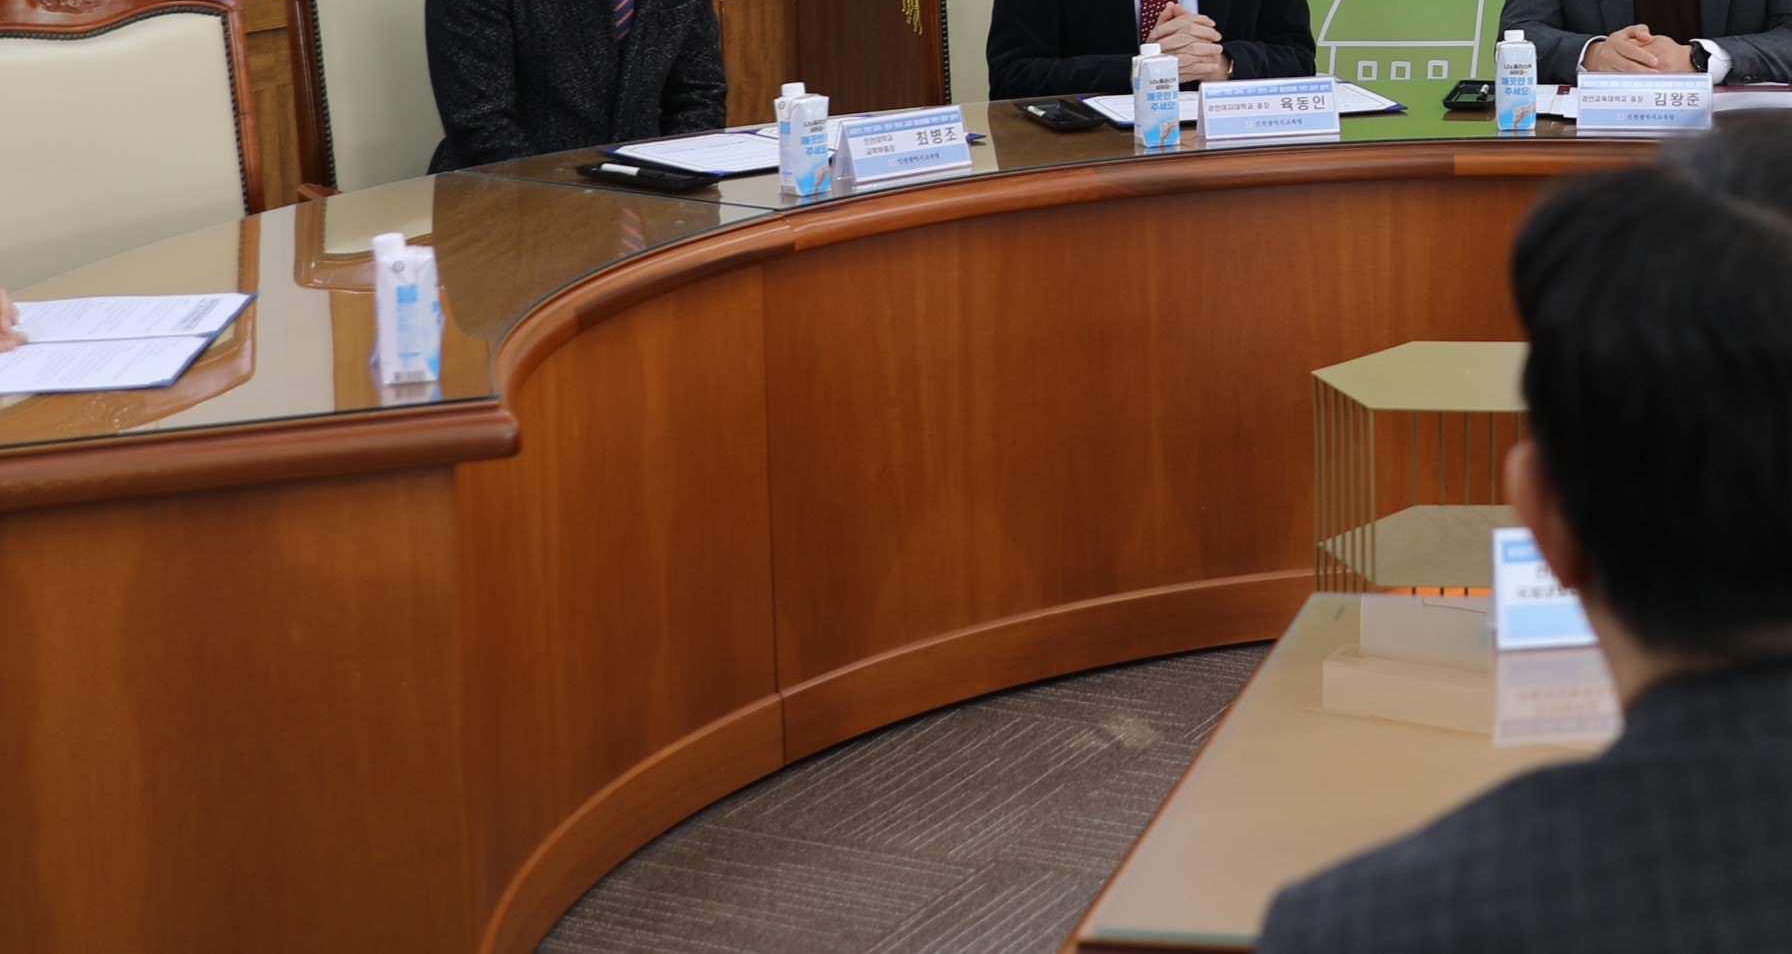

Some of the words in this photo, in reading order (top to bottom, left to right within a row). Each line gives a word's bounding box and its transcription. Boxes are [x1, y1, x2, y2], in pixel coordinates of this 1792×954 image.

[1280, 95, 1326, 111] 육동인
[1654, 92, 1700, 107] 김왕준
[916, 126, 958, 146] 최병조
